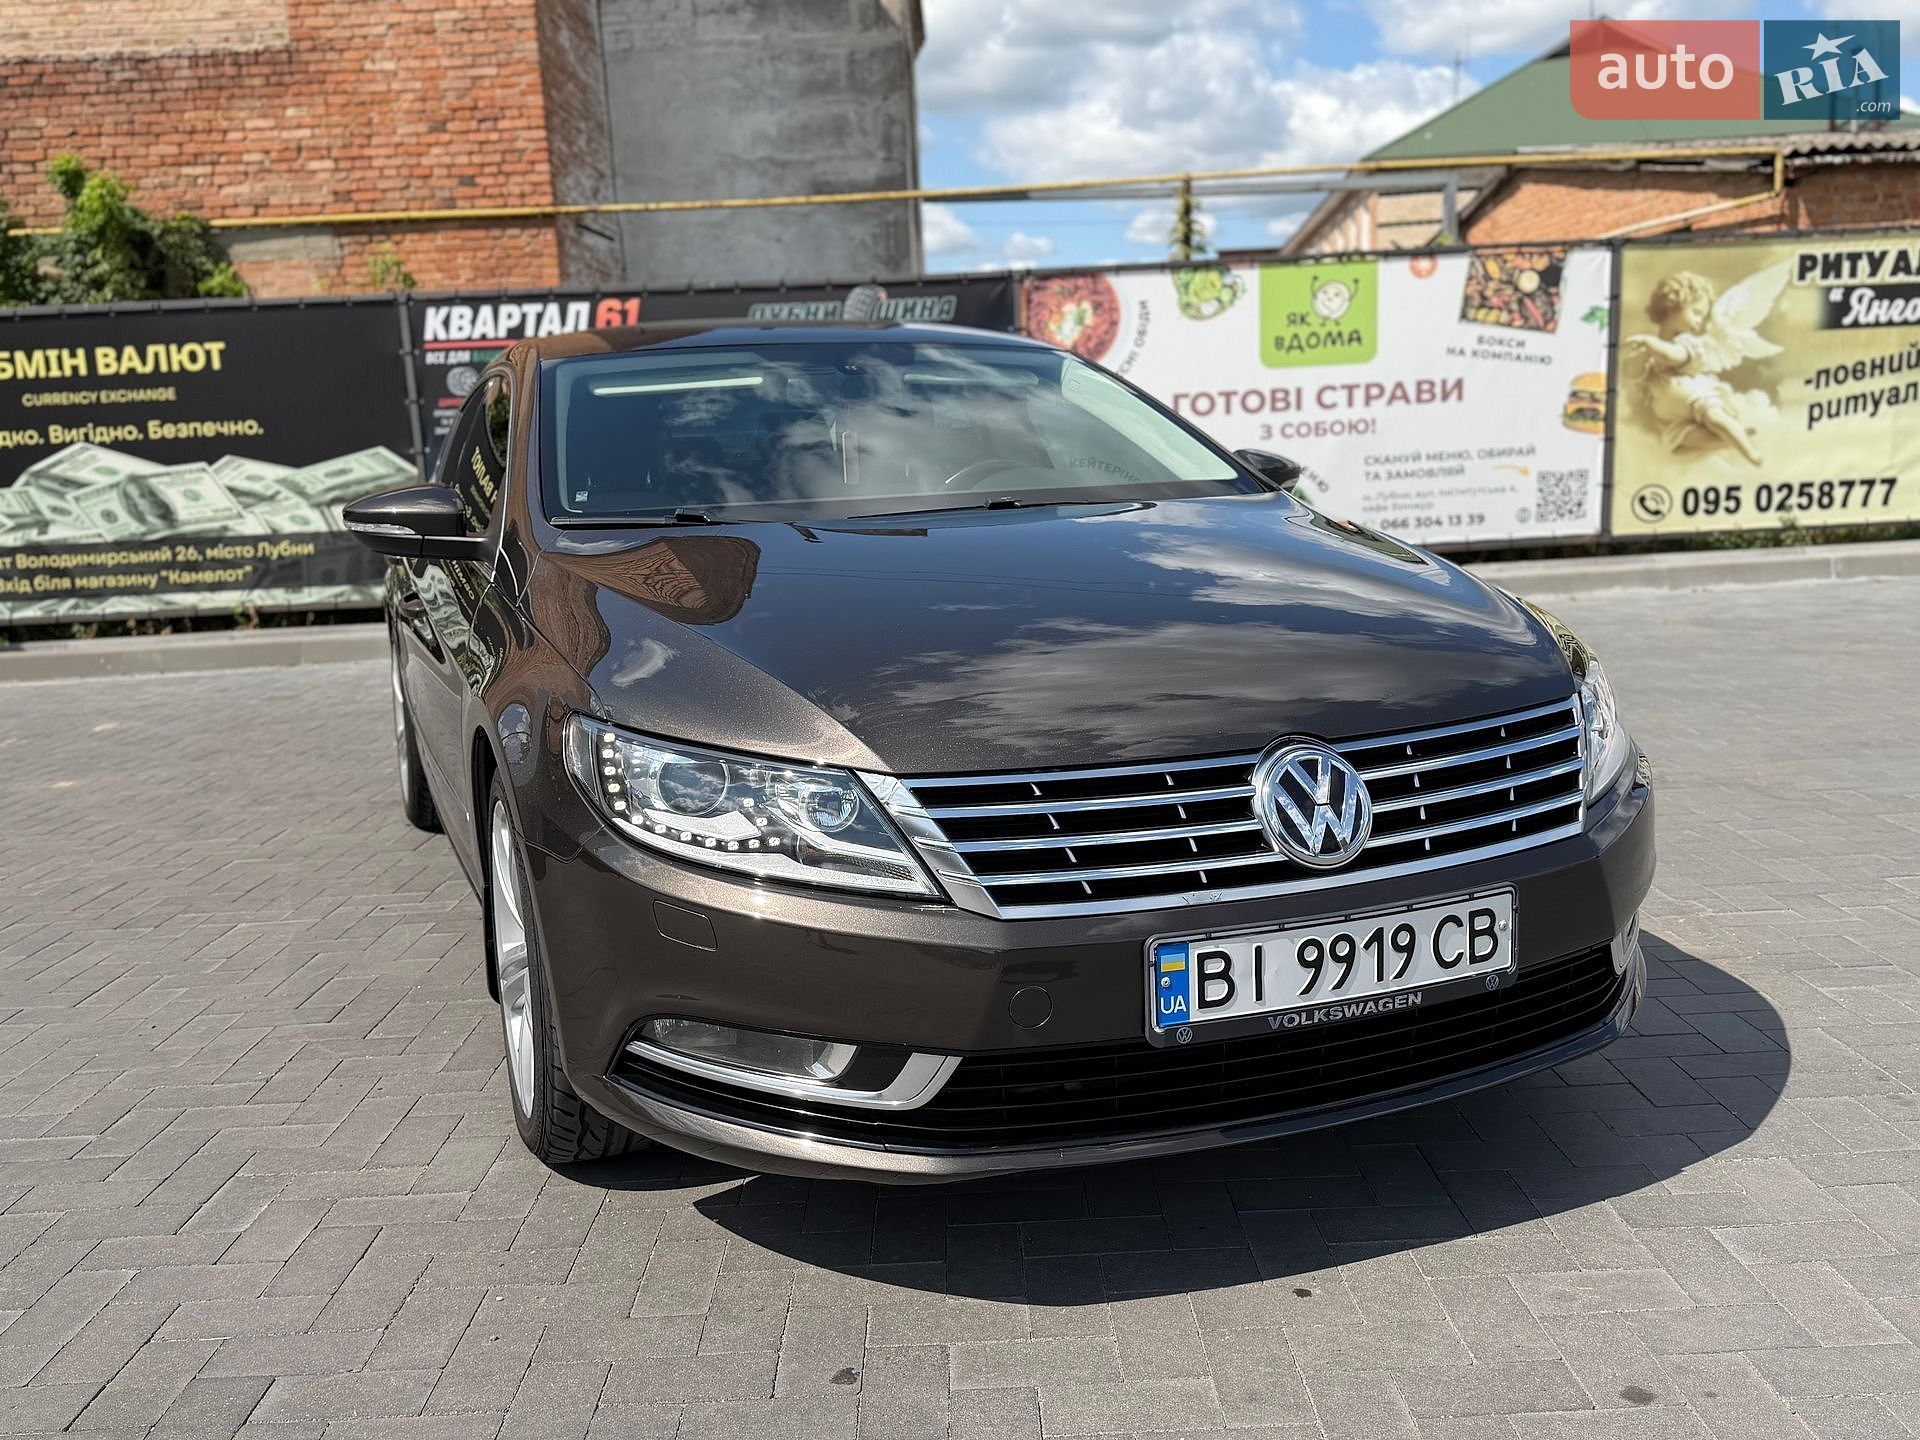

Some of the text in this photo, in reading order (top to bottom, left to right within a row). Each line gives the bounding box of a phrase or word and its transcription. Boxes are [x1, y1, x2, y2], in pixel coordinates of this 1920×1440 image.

[1798, 249, 1920, 281] РИТУА
[423, 297, 641, 341] КВАРТАЛ 61
[1285, 311, 1312, 329] ЯК
[1477, 335, 1526, 349] БОКСИ
[94, 341, 226, 376] ВАЛЮТ
[1446, 346, 1553, 367] НА КОМПАНІЮ
[21, 387, 177, 408] CURRENCY EXCHANGE
[1172, 377, 1466, 417] ГОТОВІ СТРАВИ
[47, 422, 144, 446] Вигідно.
[147, 418, 265, 441] Безпечно.
[1279, 418, 1378, 440] СОБОЮ!
[1681, 477, 1898, 517] 095 0258777
[1380, 517, 1410, 531] 066
[1414, 515, 1444, 529] 304
[15, 546, 173, 571] Володимирський
[175, 544, 204, 562] 26,
[206, 542, 255, 561] місто
[257, 539, 316, 560] Лубни
[33, 574, 73, 592] біля
[75, 573, 159, 590] магазину
[1196, 907, 1500, 1011] BI 9919 CB
[1160, 995, 1188, 1014] UA
[1267, 991, 1423, 1030] VOLKSWAGEN
